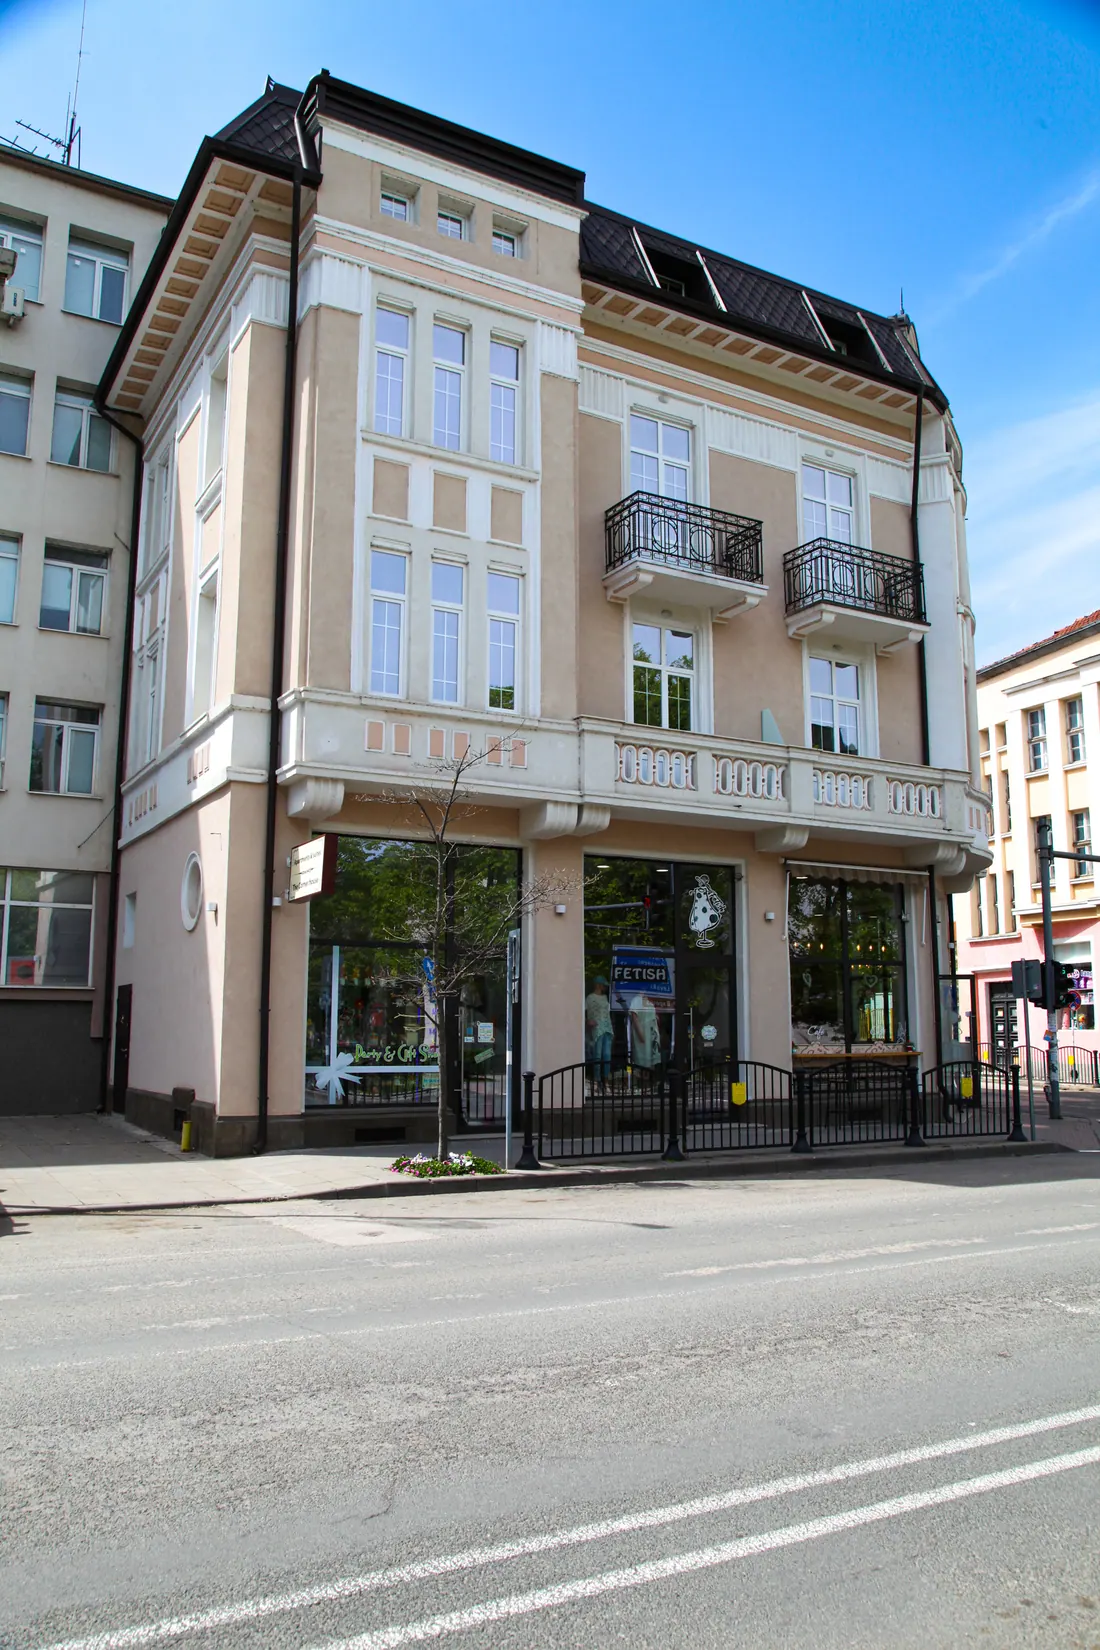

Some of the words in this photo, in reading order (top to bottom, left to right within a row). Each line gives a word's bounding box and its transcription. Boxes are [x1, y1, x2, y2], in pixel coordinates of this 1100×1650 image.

[614, 967, 666, 980] FETISH
[354, 1043, 381, 1062] Party
[383, 1045, 396, 1062] &
